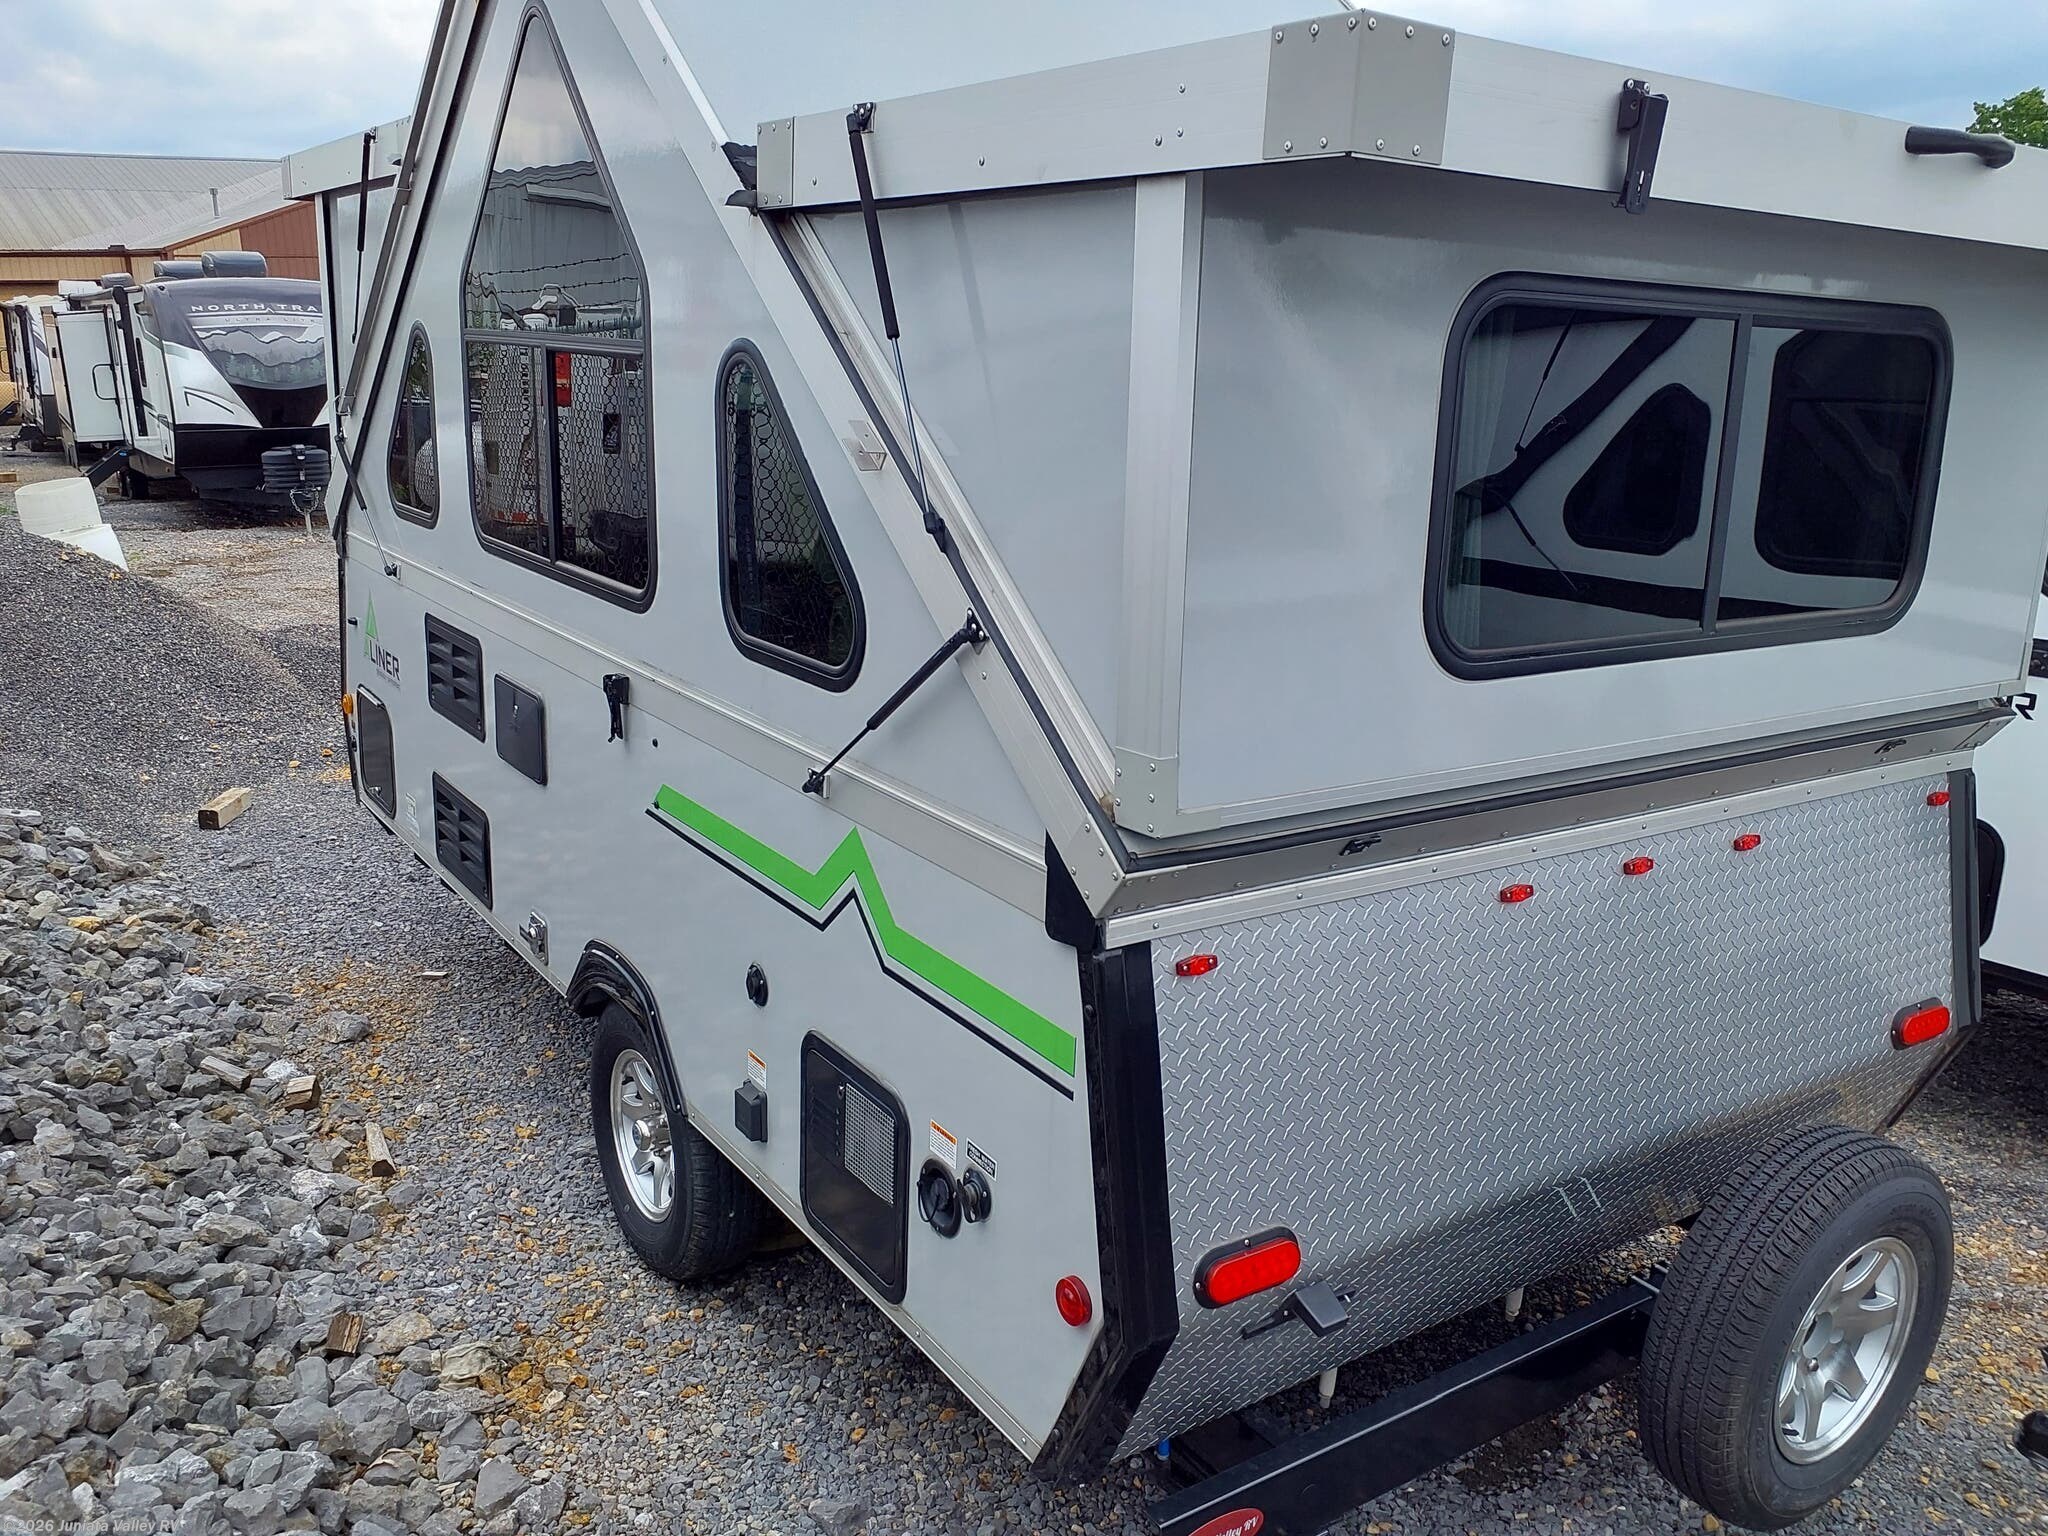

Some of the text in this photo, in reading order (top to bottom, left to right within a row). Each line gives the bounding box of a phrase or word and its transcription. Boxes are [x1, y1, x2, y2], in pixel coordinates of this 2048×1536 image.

[191, 303, 318, 312] NORTH TRA
[1243, 1515, 1259, 1531] RV
